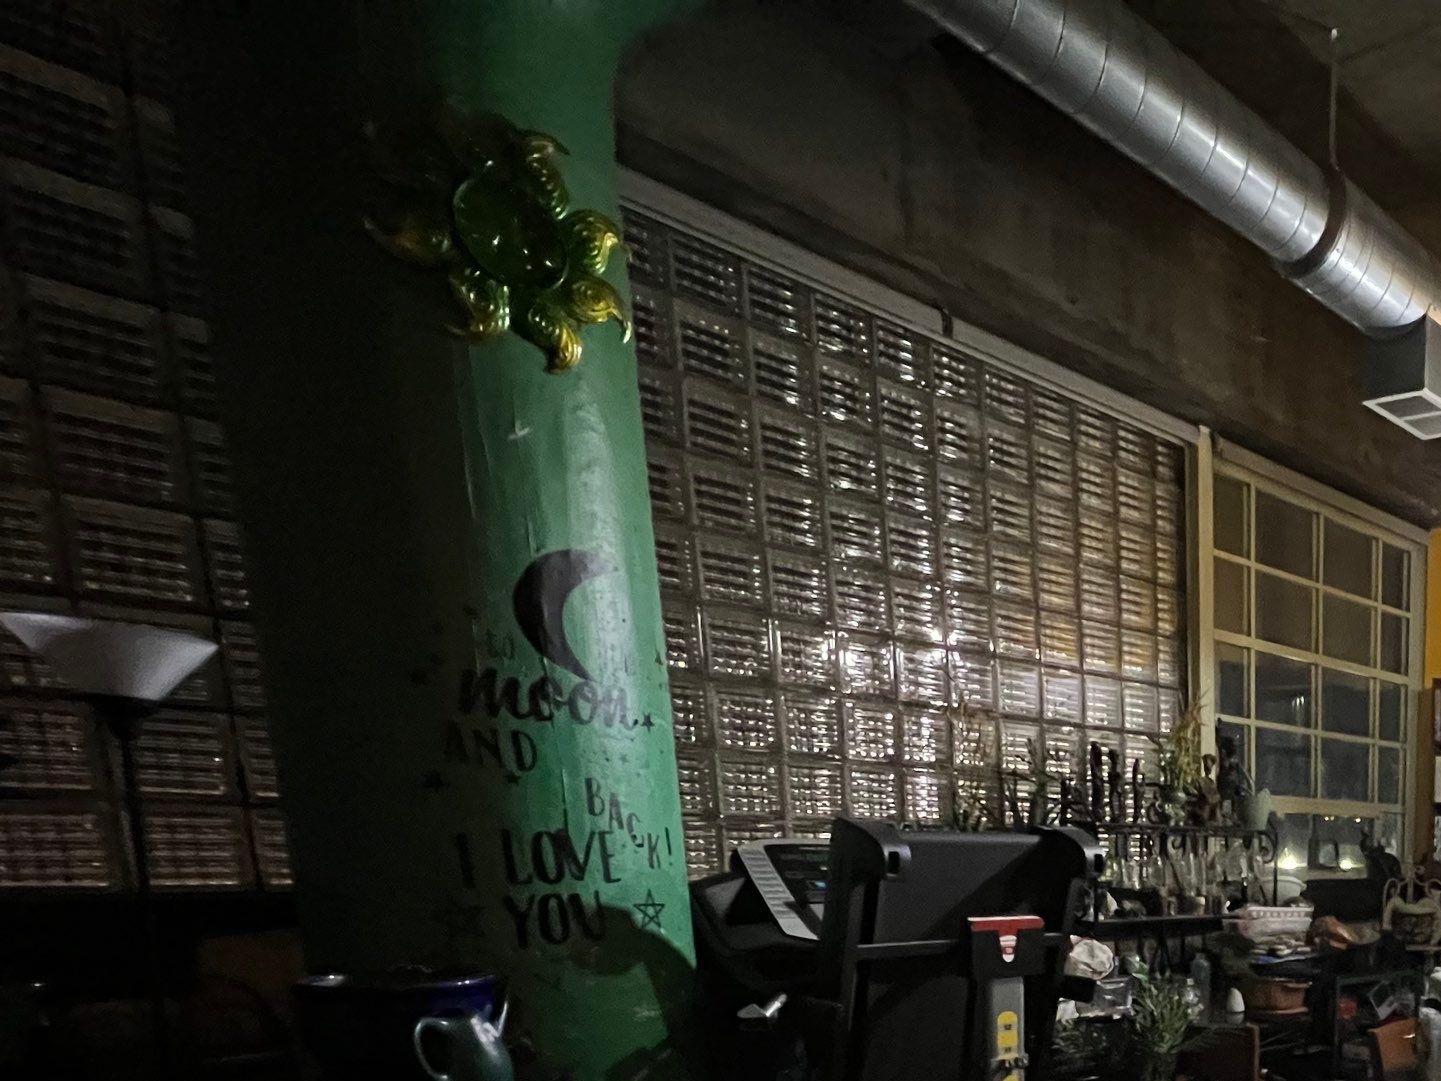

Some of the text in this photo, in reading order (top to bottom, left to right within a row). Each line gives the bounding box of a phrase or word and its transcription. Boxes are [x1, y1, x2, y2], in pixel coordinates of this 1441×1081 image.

[444, 719, 538, 772] AND
[455, 827, 622, 890] I LOVE
[502, 892, 607, 950] YOU
